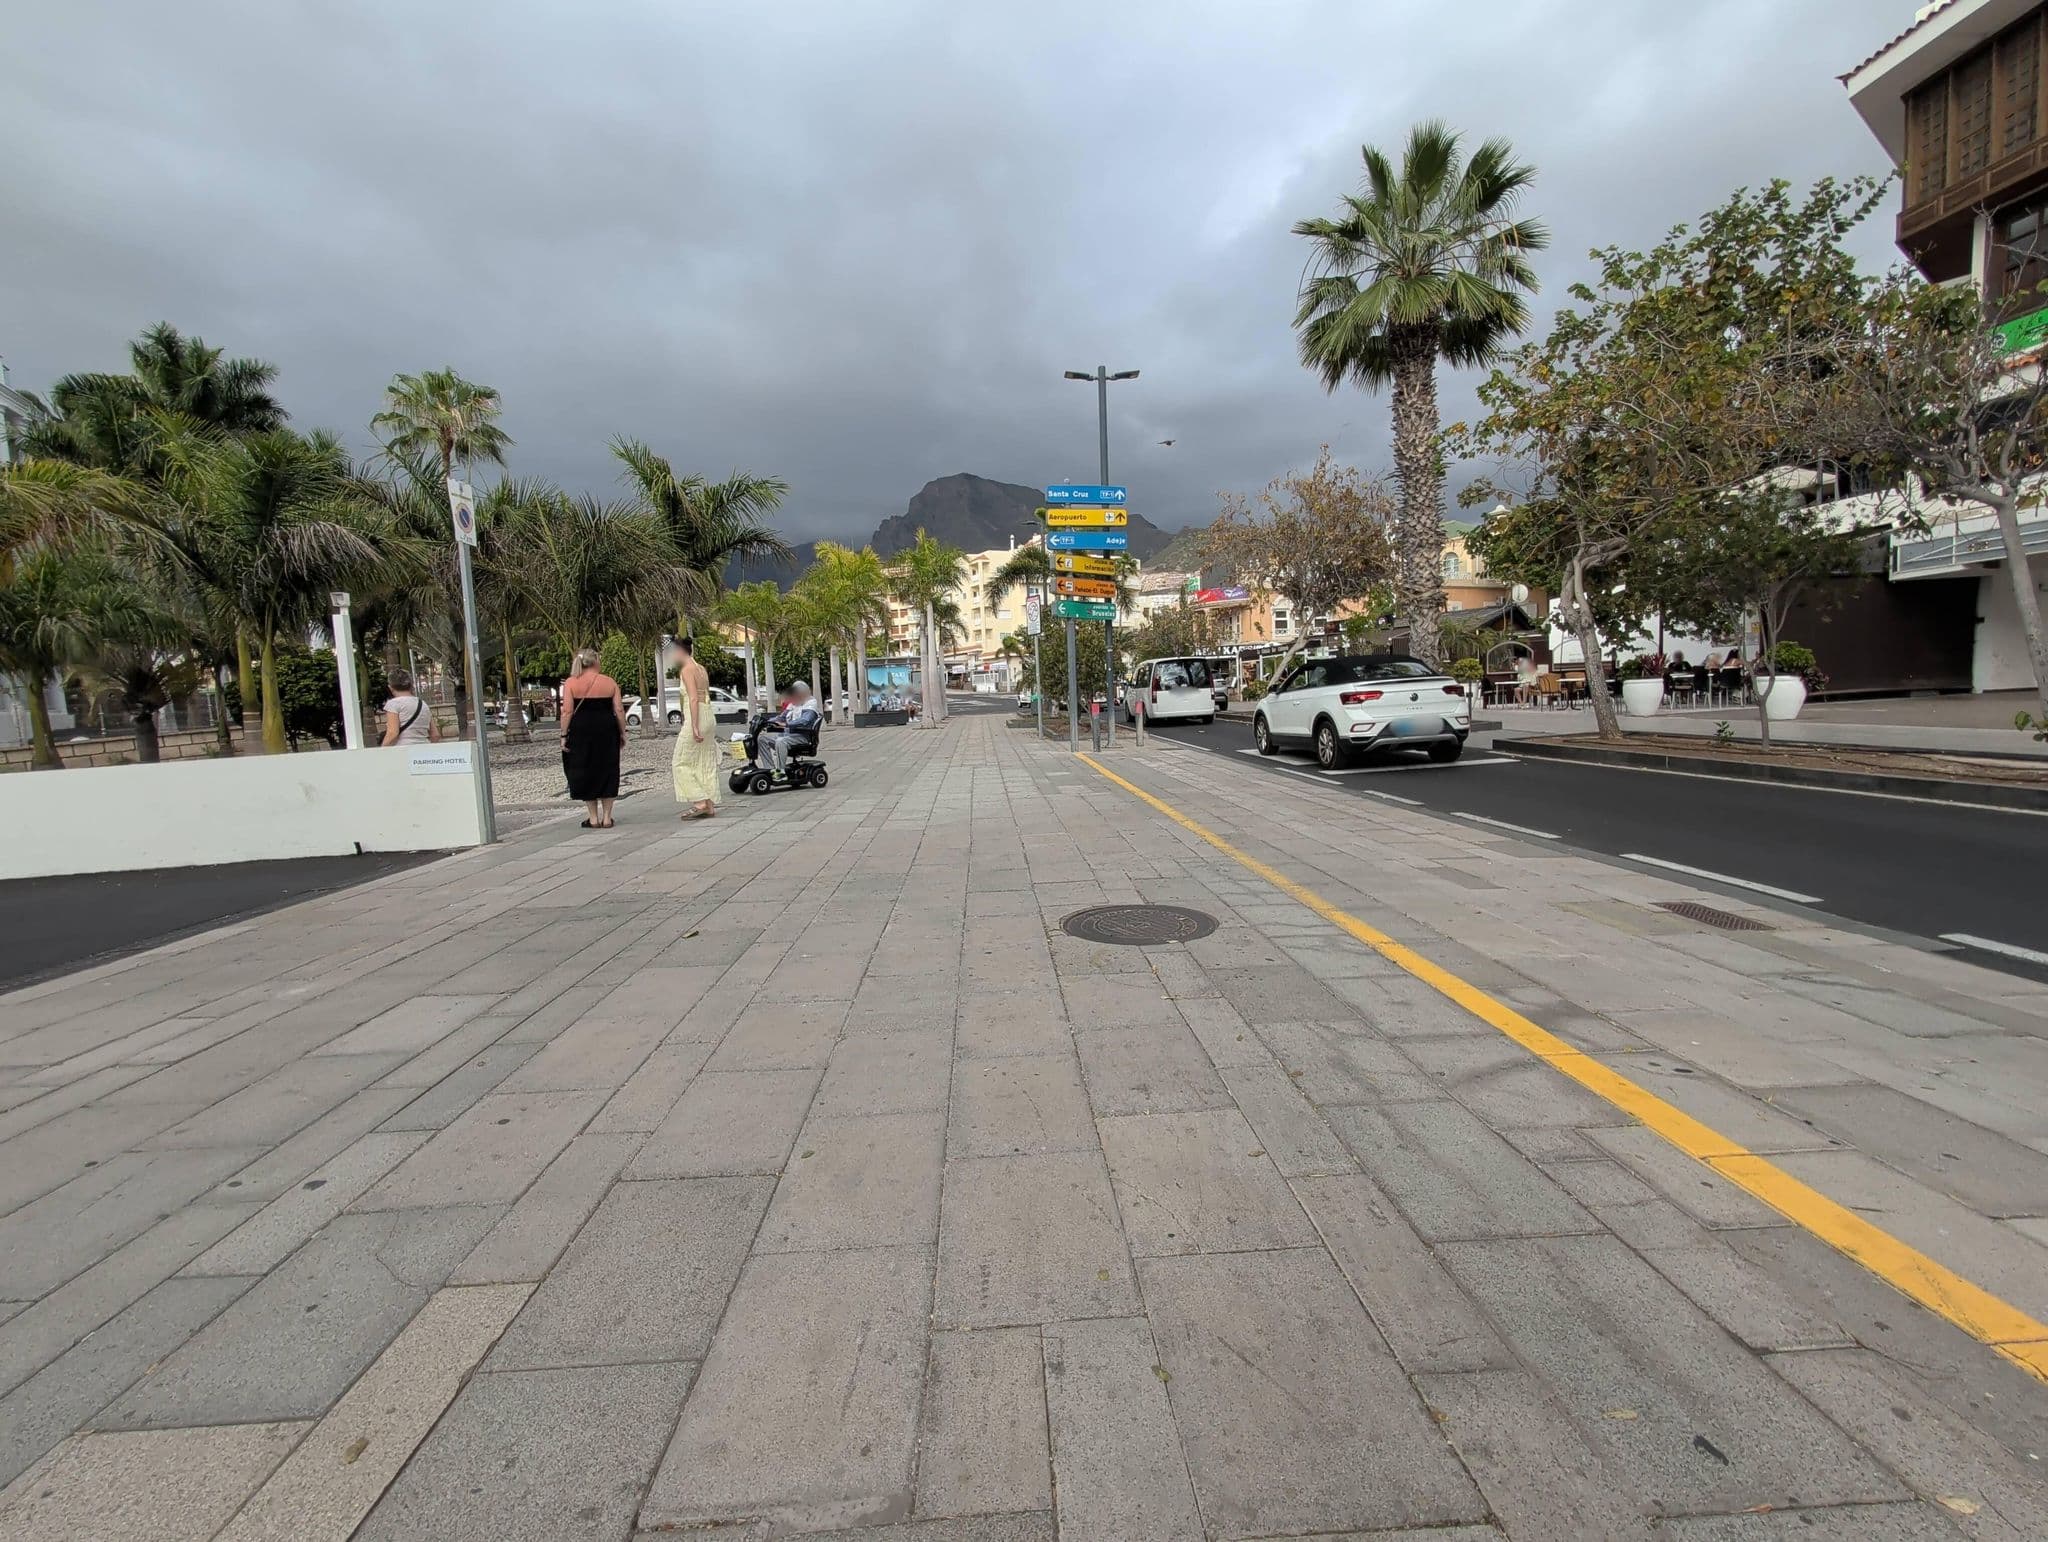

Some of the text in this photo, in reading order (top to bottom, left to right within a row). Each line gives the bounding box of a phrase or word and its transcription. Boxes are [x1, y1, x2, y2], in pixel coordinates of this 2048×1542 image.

[1048, 490, 1089, 498] Santa Cruz
[1106, 537, 1126, 545] Adeje
